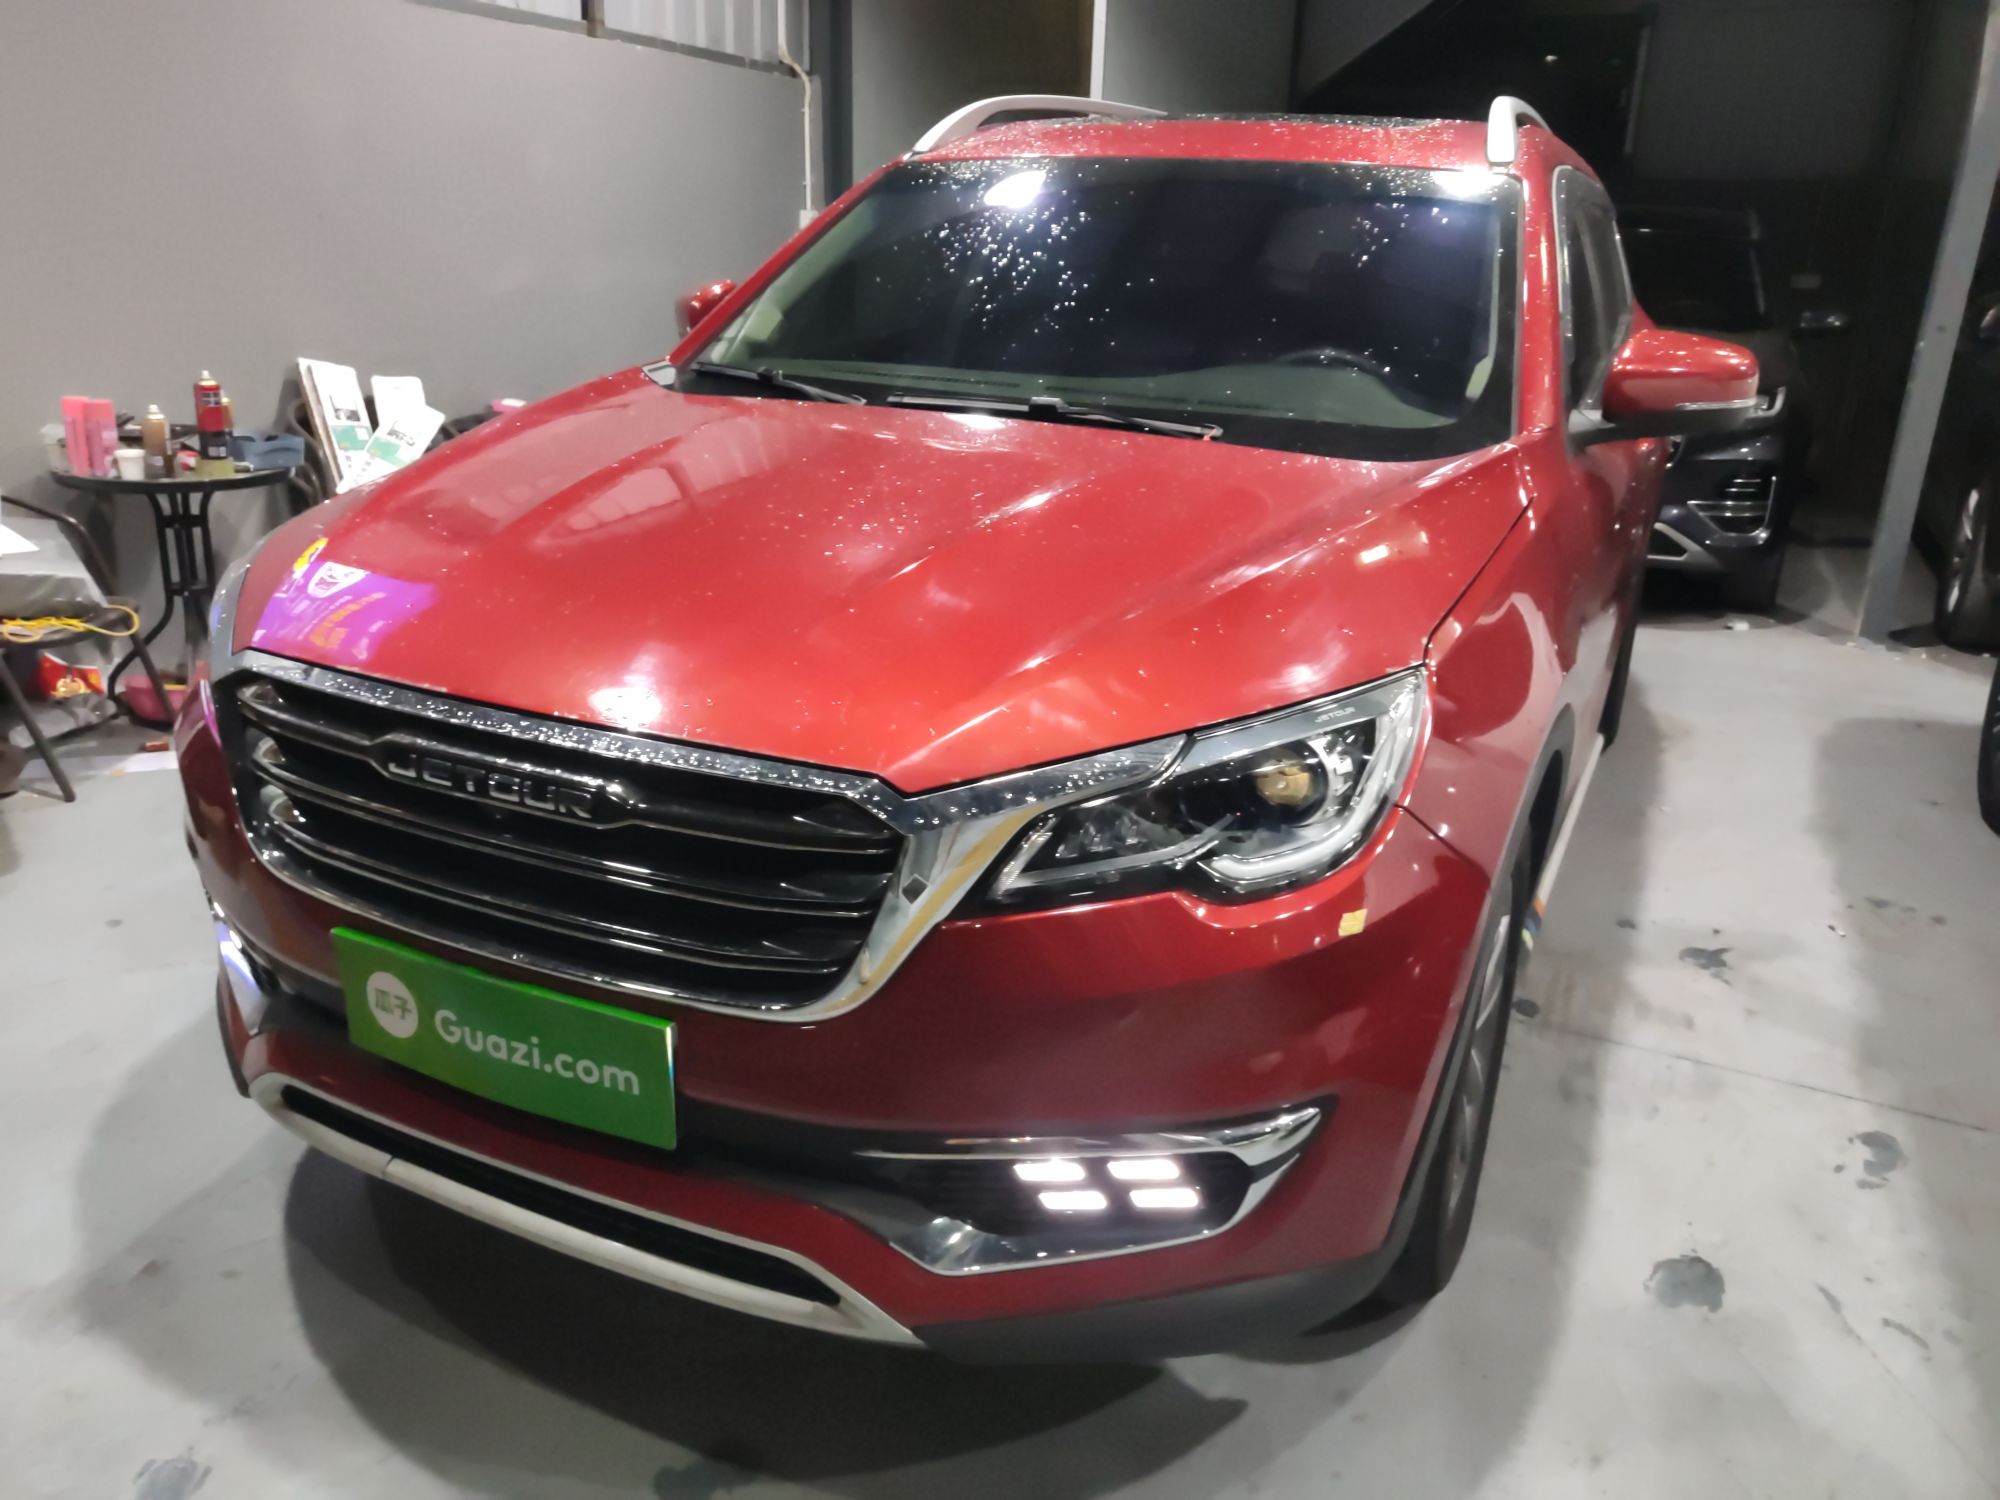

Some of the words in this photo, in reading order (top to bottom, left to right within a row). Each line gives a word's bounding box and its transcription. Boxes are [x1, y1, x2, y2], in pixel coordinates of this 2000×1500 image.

[1314, 706, 1356, 723] JETOUR
[388, 753, 593, 819] JETOUR
[434, 1009, 640, 1096] Guazi.com
